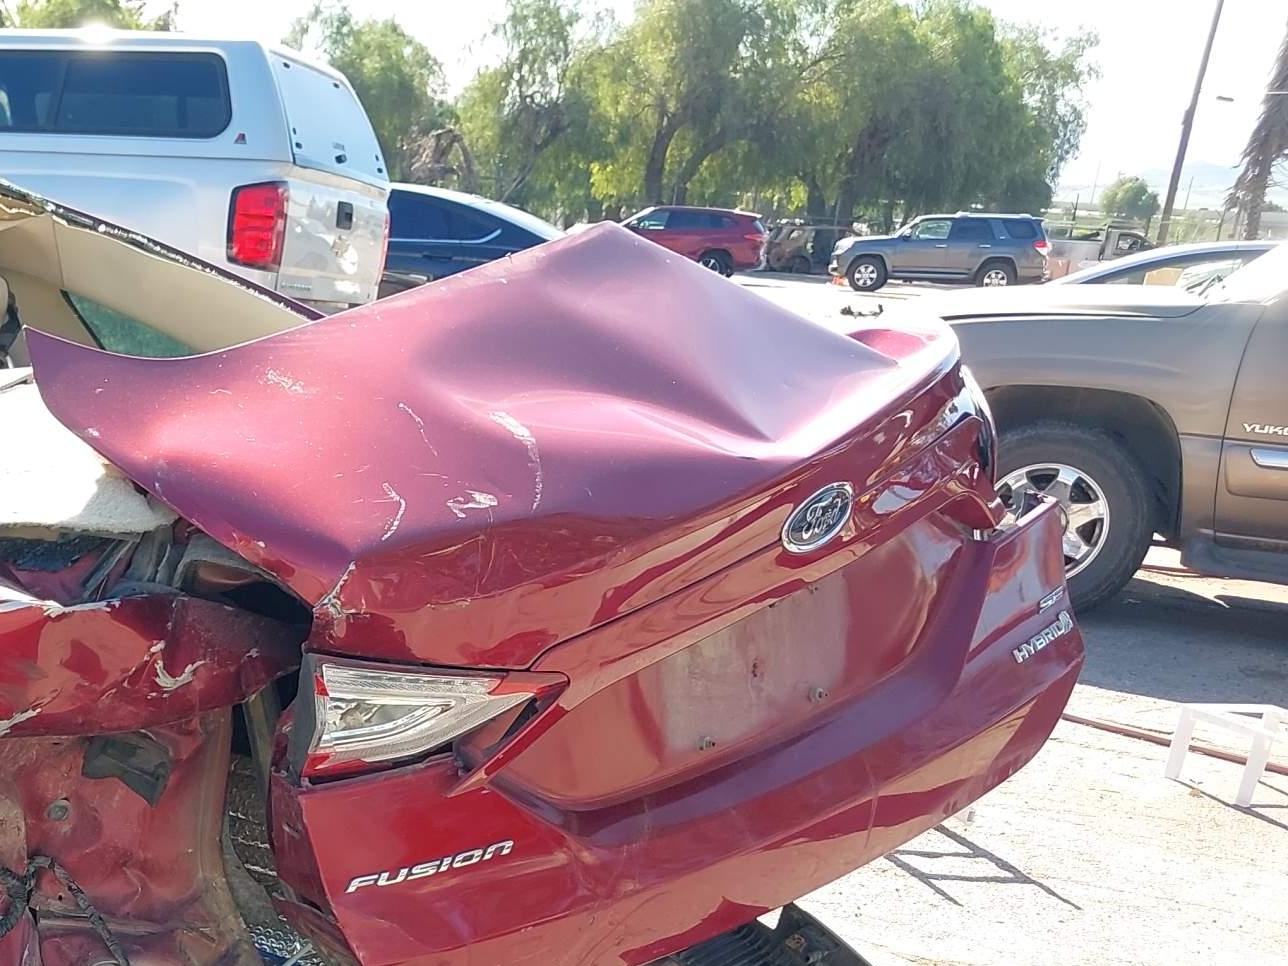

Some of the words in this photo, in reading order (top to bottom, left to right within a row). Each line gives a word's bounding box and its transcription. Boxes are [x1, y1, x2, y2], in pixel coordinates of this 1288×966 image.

[1039, 585, 1064, 614] SE
[1013, 618, 1066, 663] HYBRID
[344, 840, 514, 894] FUSION
